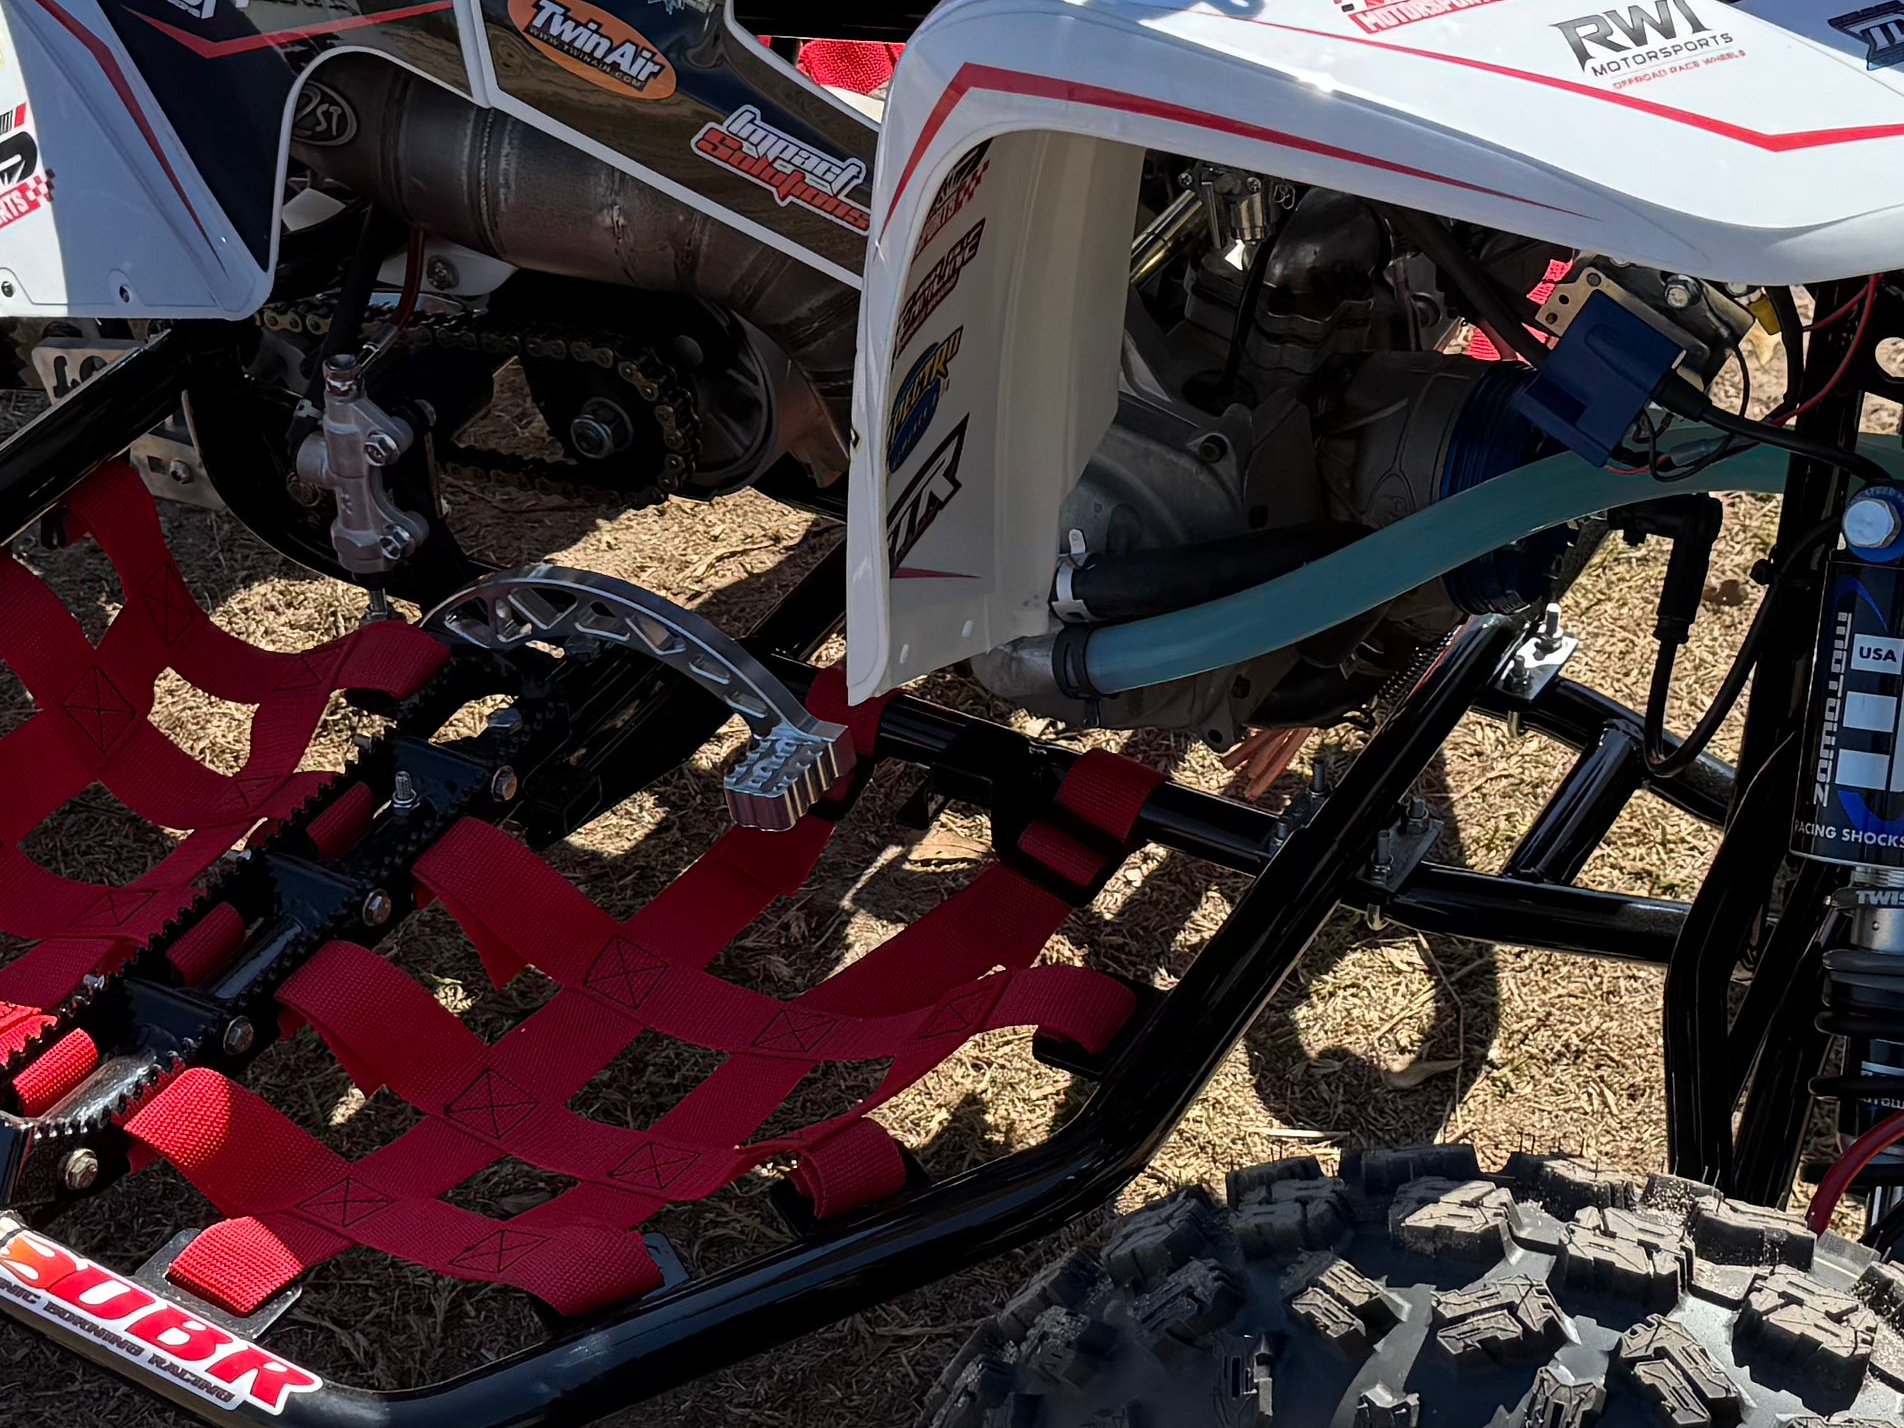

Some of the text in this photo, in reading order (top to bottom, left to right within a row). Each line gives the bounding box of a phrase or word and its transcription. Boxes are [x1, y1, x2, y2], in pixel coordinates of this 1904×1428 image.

[1590, 30, 1734, 79] MOTORSPORTS
[1612, 48, 1747, 91] OFFROAD RACE WHEELS
[726, 108, 865, 196] Impact
[1858, 645, 1898, 663] USA
[49, 1259, 320, 1406] DBR
[147, 1350, 236, 1404] RACING
